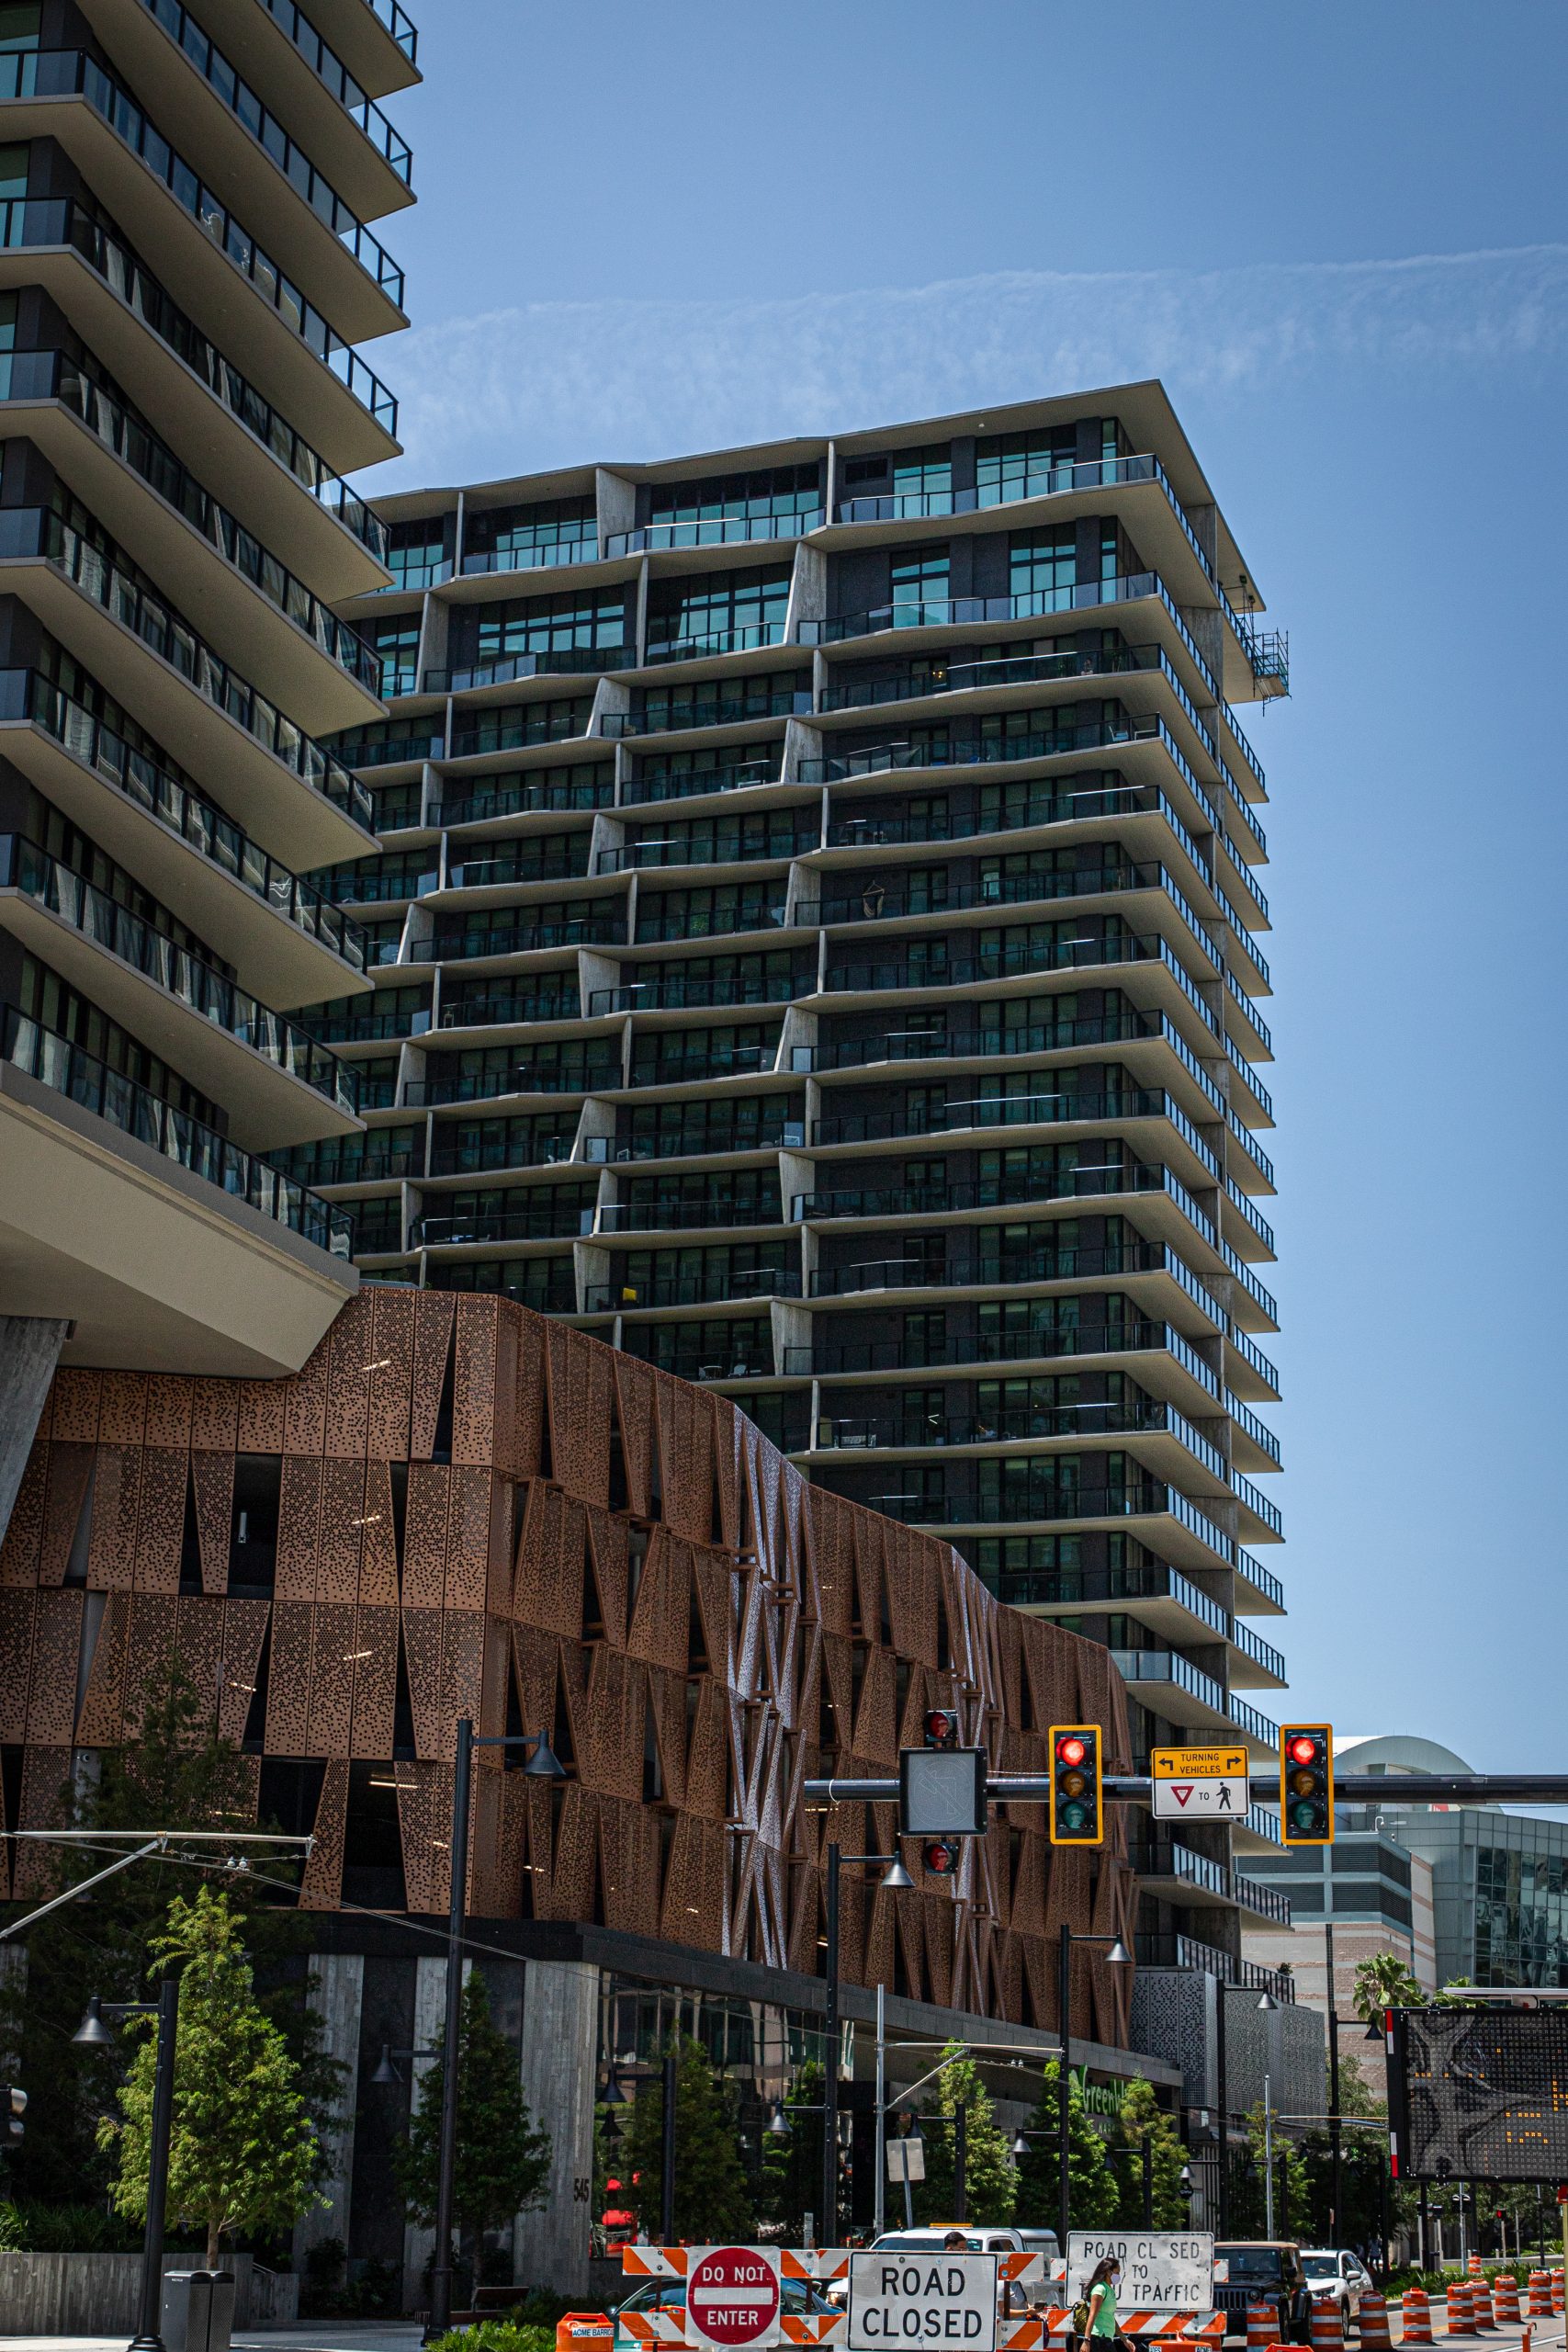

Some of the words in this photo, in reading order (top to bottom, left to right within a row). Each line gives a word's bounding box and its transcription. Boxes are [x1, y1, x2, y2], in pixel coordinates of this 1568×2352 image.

[1181, 1753, 1219, 1761] TURNING
[1180, 1765, 1221, 1774] VEHICLES
[1199, 1792, 1210, 1801] TO
[574, 2177, 589, 2202] 545
[1084, 2242, 1127, 2258] ROAD
[1138, 2242, 1200, 2259] CLSED
[703, 2267, 725, 2281] DO
[734, 2267, 766, 2281] NOT
[1132, 2264, 1148, 2278] TO
[882, 2267, 965, 2297] ROAD
[707, 2310, 759, 2325] ENTER
[863, 2307, 982, 2338] CLOSED
